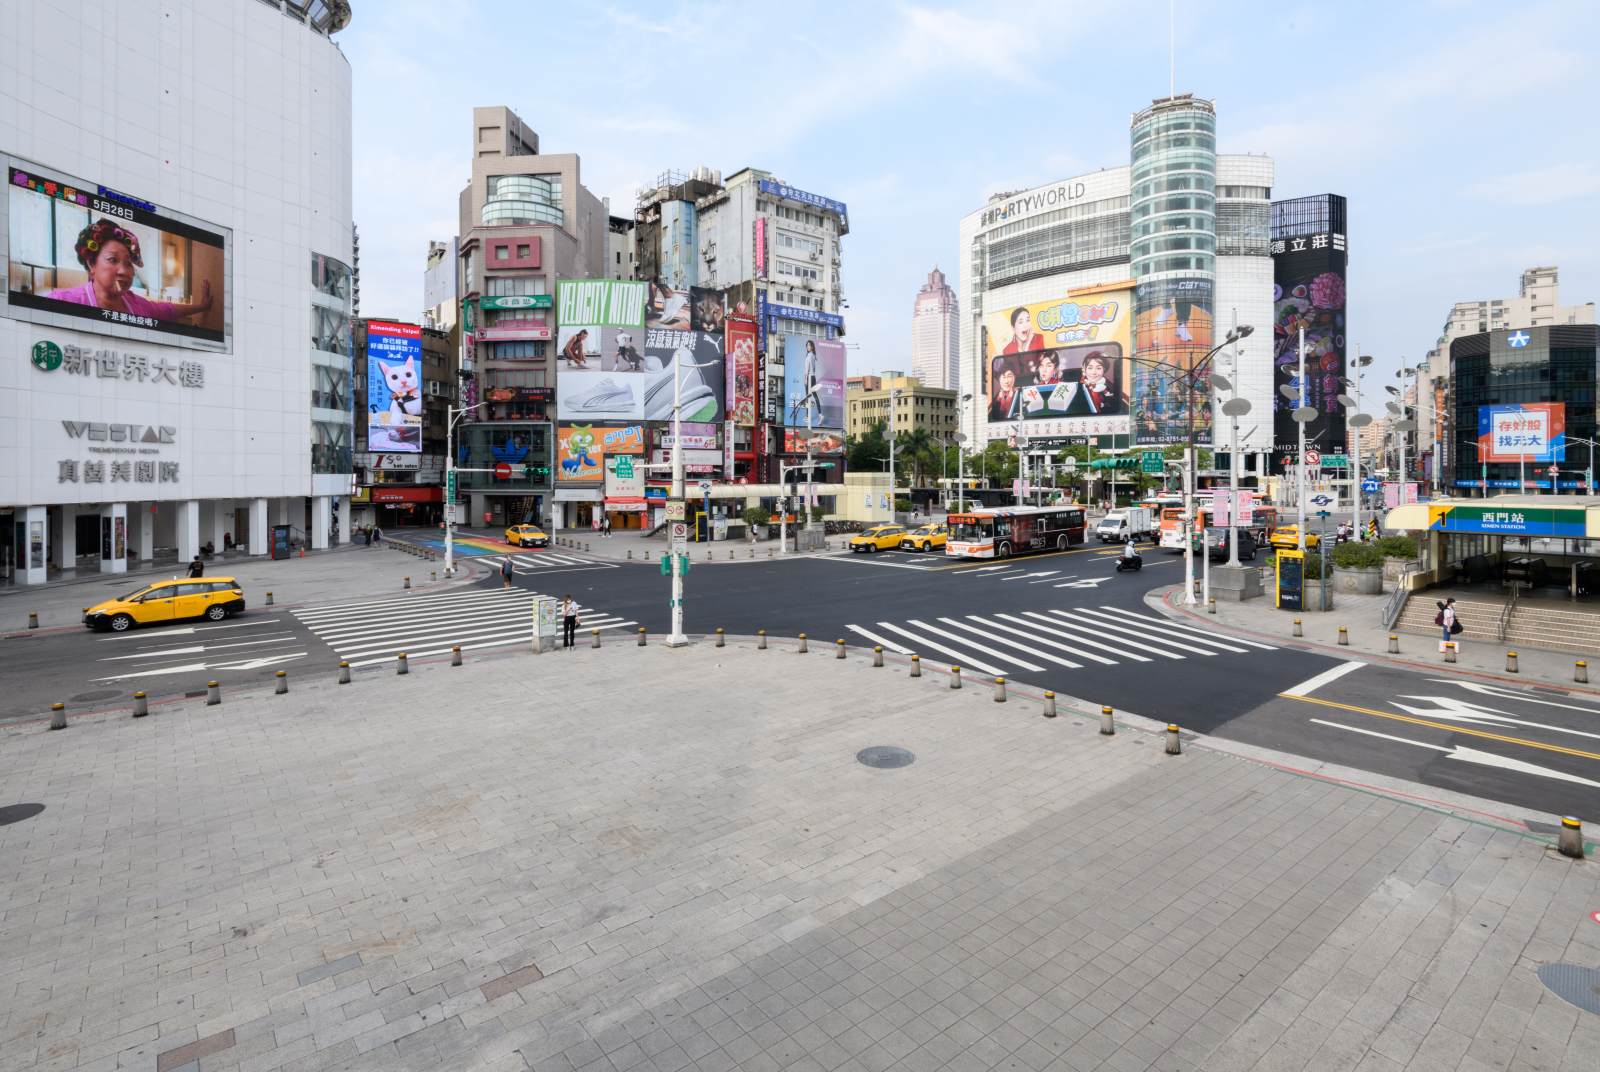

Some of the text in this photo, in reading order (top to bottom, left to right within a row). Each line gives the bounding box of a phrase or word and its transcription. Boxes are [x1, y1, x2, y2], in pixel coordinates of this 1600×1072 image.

[97, 185, 156, 213] Panasonic
[93, 199, 133, 220] 5月28日
[1270, 234, 1329, 254] 德立莊
[559, 282, 644, 325] VELOCITY NITRO
[370, 324, 420, 335] Ximending Taipei
[63, 344, 206, 389] 新世界大樓
[61, 420, 177, 444] WESTAR
[1499, 419, 1541, 432] 存好股
[1499, 434, 1541, 447] 找元大
[57, 459, 180, 484] 真善美劇院
[1437, 511, 1447, 527] 1
[1482, 512, 1525, 524] 西門站
